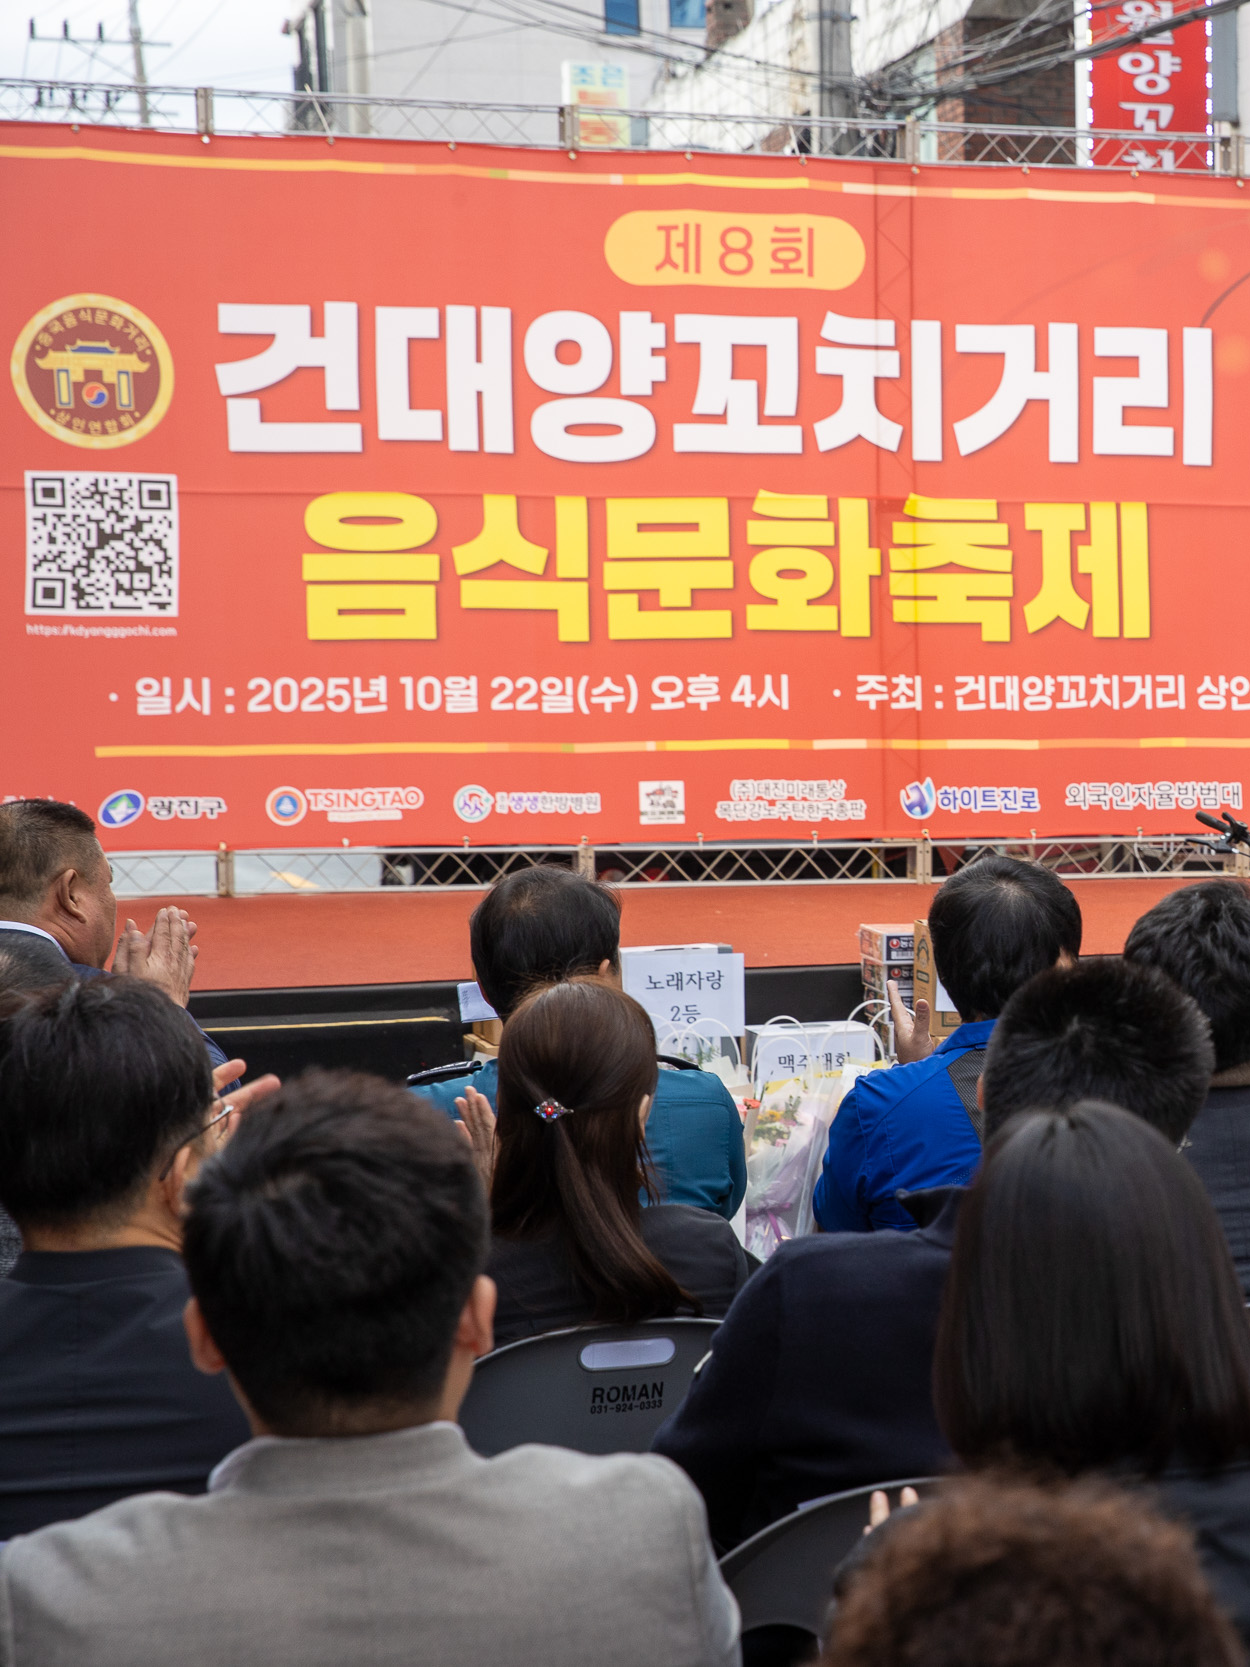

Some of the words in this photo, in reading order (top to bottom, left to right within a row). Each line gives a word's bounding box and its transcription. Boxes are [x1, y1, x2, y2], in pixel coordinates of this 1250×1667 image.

[214, 301, 1213, 467] 건대양꼬치거리
[302, 488, 1151, 642] 음식문화축제
[135, 676, 211, 715] 일시
[246, 675, 389, 714] 2025년
[400, 675, 479, 713] 10월
[490, 674, 639, 715] 22일(수)
[650, 673, 721, 711] 오후
[731, 673, 790, 711] 4시
[855, 674, 923, 711] 주최
[954, 673, 1186, 712] 건대양꼬치거리
[310, 789, 421, 808] TSINGTAO
[938, 786, 1038, 811] 하이트진로
[1067, 782, 1242, 809] 외국인자율방범대
[151, 798, 224, 819] 광진구
[645, 970, 725, 992] 노래자랑
[670, 1004, 702, 1025] 2등
[591, 1381, 664, 1404] ROMAN
[590, 1400, 663, 1415] 031-924-0333
